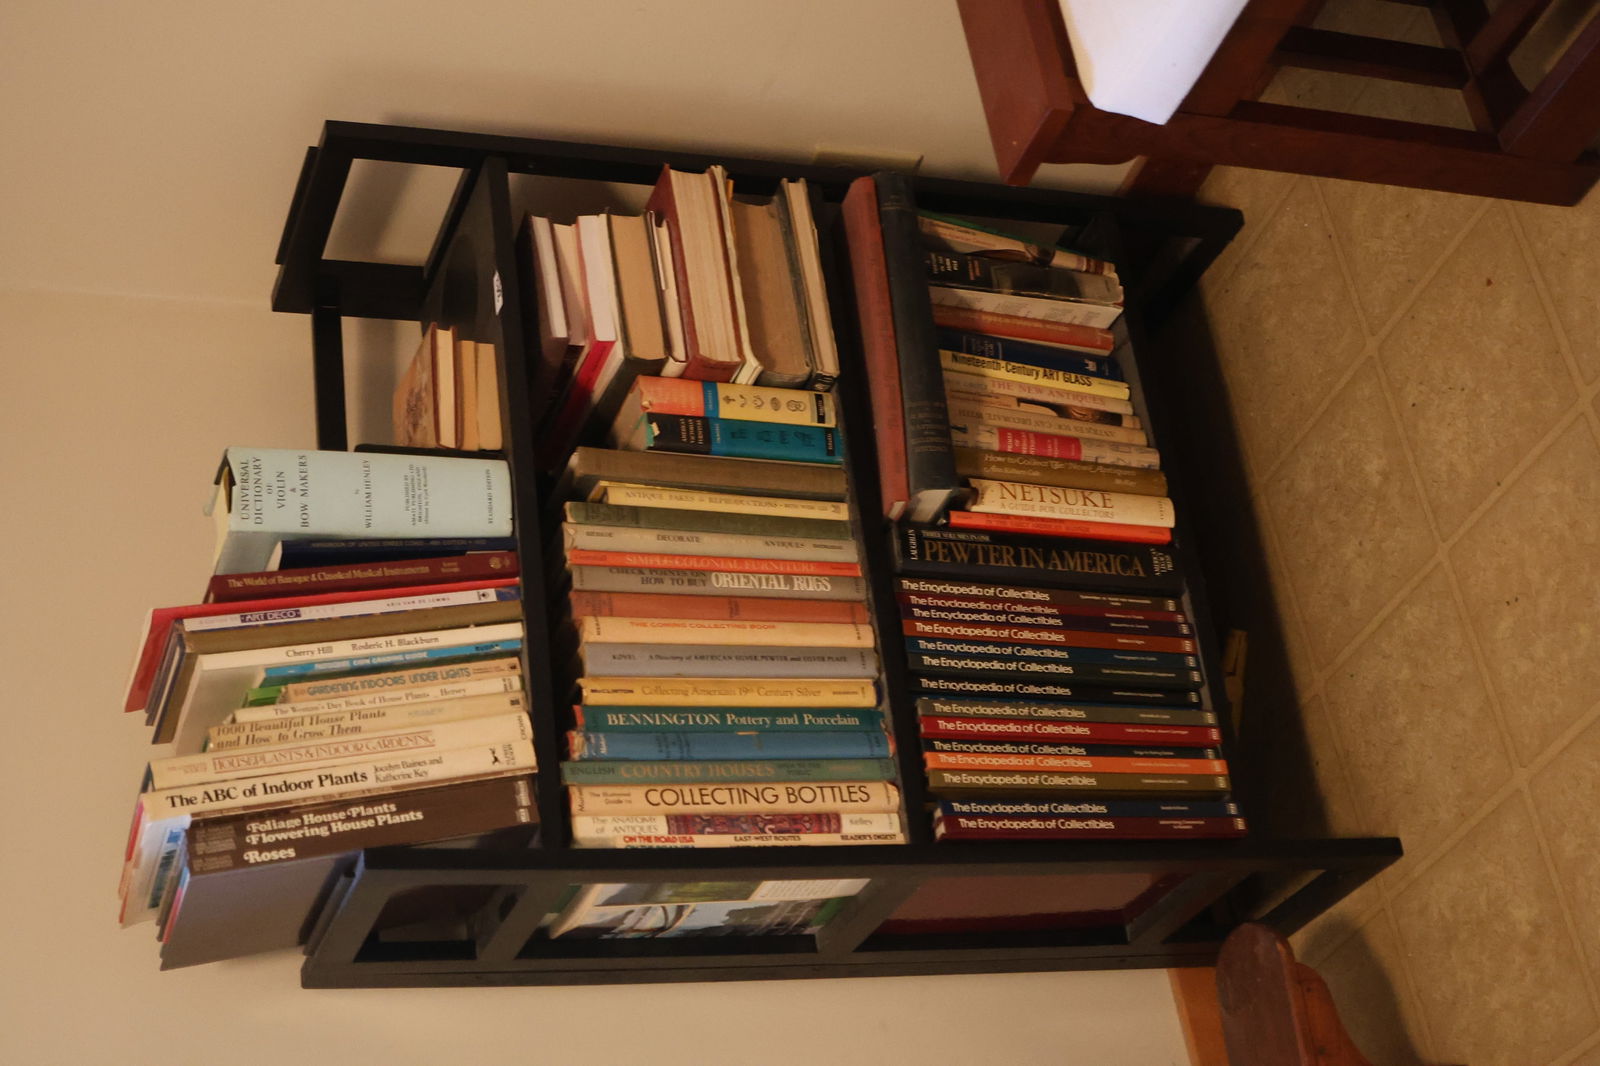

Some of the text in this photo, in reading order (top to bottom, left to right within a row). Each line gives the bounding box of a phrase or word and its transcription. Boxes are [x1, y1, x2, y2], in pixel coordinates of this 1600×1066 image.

[951, 351, 1093, 388] Nineteenth-Century ART GLASS
[990, 379, 1106, 407] THE NEW ANTIQUES
[985, 453, 1005, 464] How
[1016, 455, 1049, 468] Collect
[240, 459, 250, 520] UNIVERSAL
[252, 456, 263, 525] DICTIONARY
[276, 471, 286, 509] VIOLIN
[298, 455, 309, 528] BOW MAKERS
[362, 459, 372, 529] WILLIAM HENLEY
[999, 483, 1116, 509] NETSUKE
[625, 491, 664, 500] ANTIQUE
[668, 493, 697, 502] FAKES
[707, 496, 778, 509] REPRODUCTIONS
[1007, 503, 1038, 512] GUIDE
[1040, 505, 1058, 513] FOR
[1060, 507, 1115, 520] COLLECTORS
[657, 533, 702, 544] DECORATE
[764, 540, 805, 549] ANTIQUES
[625, 553, 818, 573] SIMPLE COLONIAL FURNITURE
[923, 539, 1147, 578] PEWTER IN AMERICA
[227, 579, 243, 588] The
[244, 575, 266, 586] World
[267, 576, 276, 585] of
[352, 568, 384, 579] Musical
[383, 566, 430, 577] Instruments
[608, 567, 707, 577] CHECK POINTS ON
[641, 572, 832, 592] HOW TO BUY ORIENTAL RUGS
[901, 580, 1050, 601] The Encyclopedia of Collectibles
[245, 610, 297, 622] ART DECO
[915, 622, 1065, 642] The Encyclopedia of Collectibles
[286, 645, 333, 658] Cherry Hill
[352, 634, 440, 651] Roderic H. Blackburn
[306, 680, 359, 696] GARDENING
[359, 675, 406, 689] INDOORS
[409, 671, 438, 684] UNDER
[439, 667, 472, 680] LIGHTS
[641, 685, 690, 696] Collecting
[690, 686, 737, 696] American
[757, 687, 794, 698] Century
[795, 687, 822, 697] Silver
[933, 703, 1086, 718] The Encyclopedia of Collectibles
[216, 709, 387, 737] 1000 Beautiful House Plants
[606, 713, 861, 728] BENNINGTON Pottery and Porcelain
[938, 721, 1090, 735] The Encyclopedia of Collectibles
[216, 724, 362, 748] and How to Grow Them
[214, 751, 300, 770] HOUSEPLANTS
[301, 748, 313, 758] &
[314, 740, 363, 758] INDOOR
[364, 734, 435, 752] GARDENING
[938, 754, 1092, 768] The Encyclopedia of Collectibles
[401, 757, 427, 769] Baines
[429, 756, 443, 766] and
[570, 766, 616, 776] ENGLISH
[620, 763, 702, 778] COUNTRY
[707, 763, 776, 777] HOUSES
[166, 767, 368, 810] The ABC of Indoor Plants
[645, 786, 780, 807] COLLECTING
[784, 785, 872, 804] BOTTLES
[246, 802, 398, 834] Foliage House Plants
[952, 803, 1108, 815] The Encyclopedia of Collectibles
[245, 810, 424, 845] Flowering House Plants
[596, 825, 660, 835] of ANTIQUES
[611, 817, 658, 825] ANATOMY
[959, 819, 1115, 832] The Encyclopedia of Collectibles
[623, 834, 696, 844] ON THE ROAD USA
[734, 834, 801, 842] EAST-WEST ROUTES
[243, 846, 296, 863] Roses
